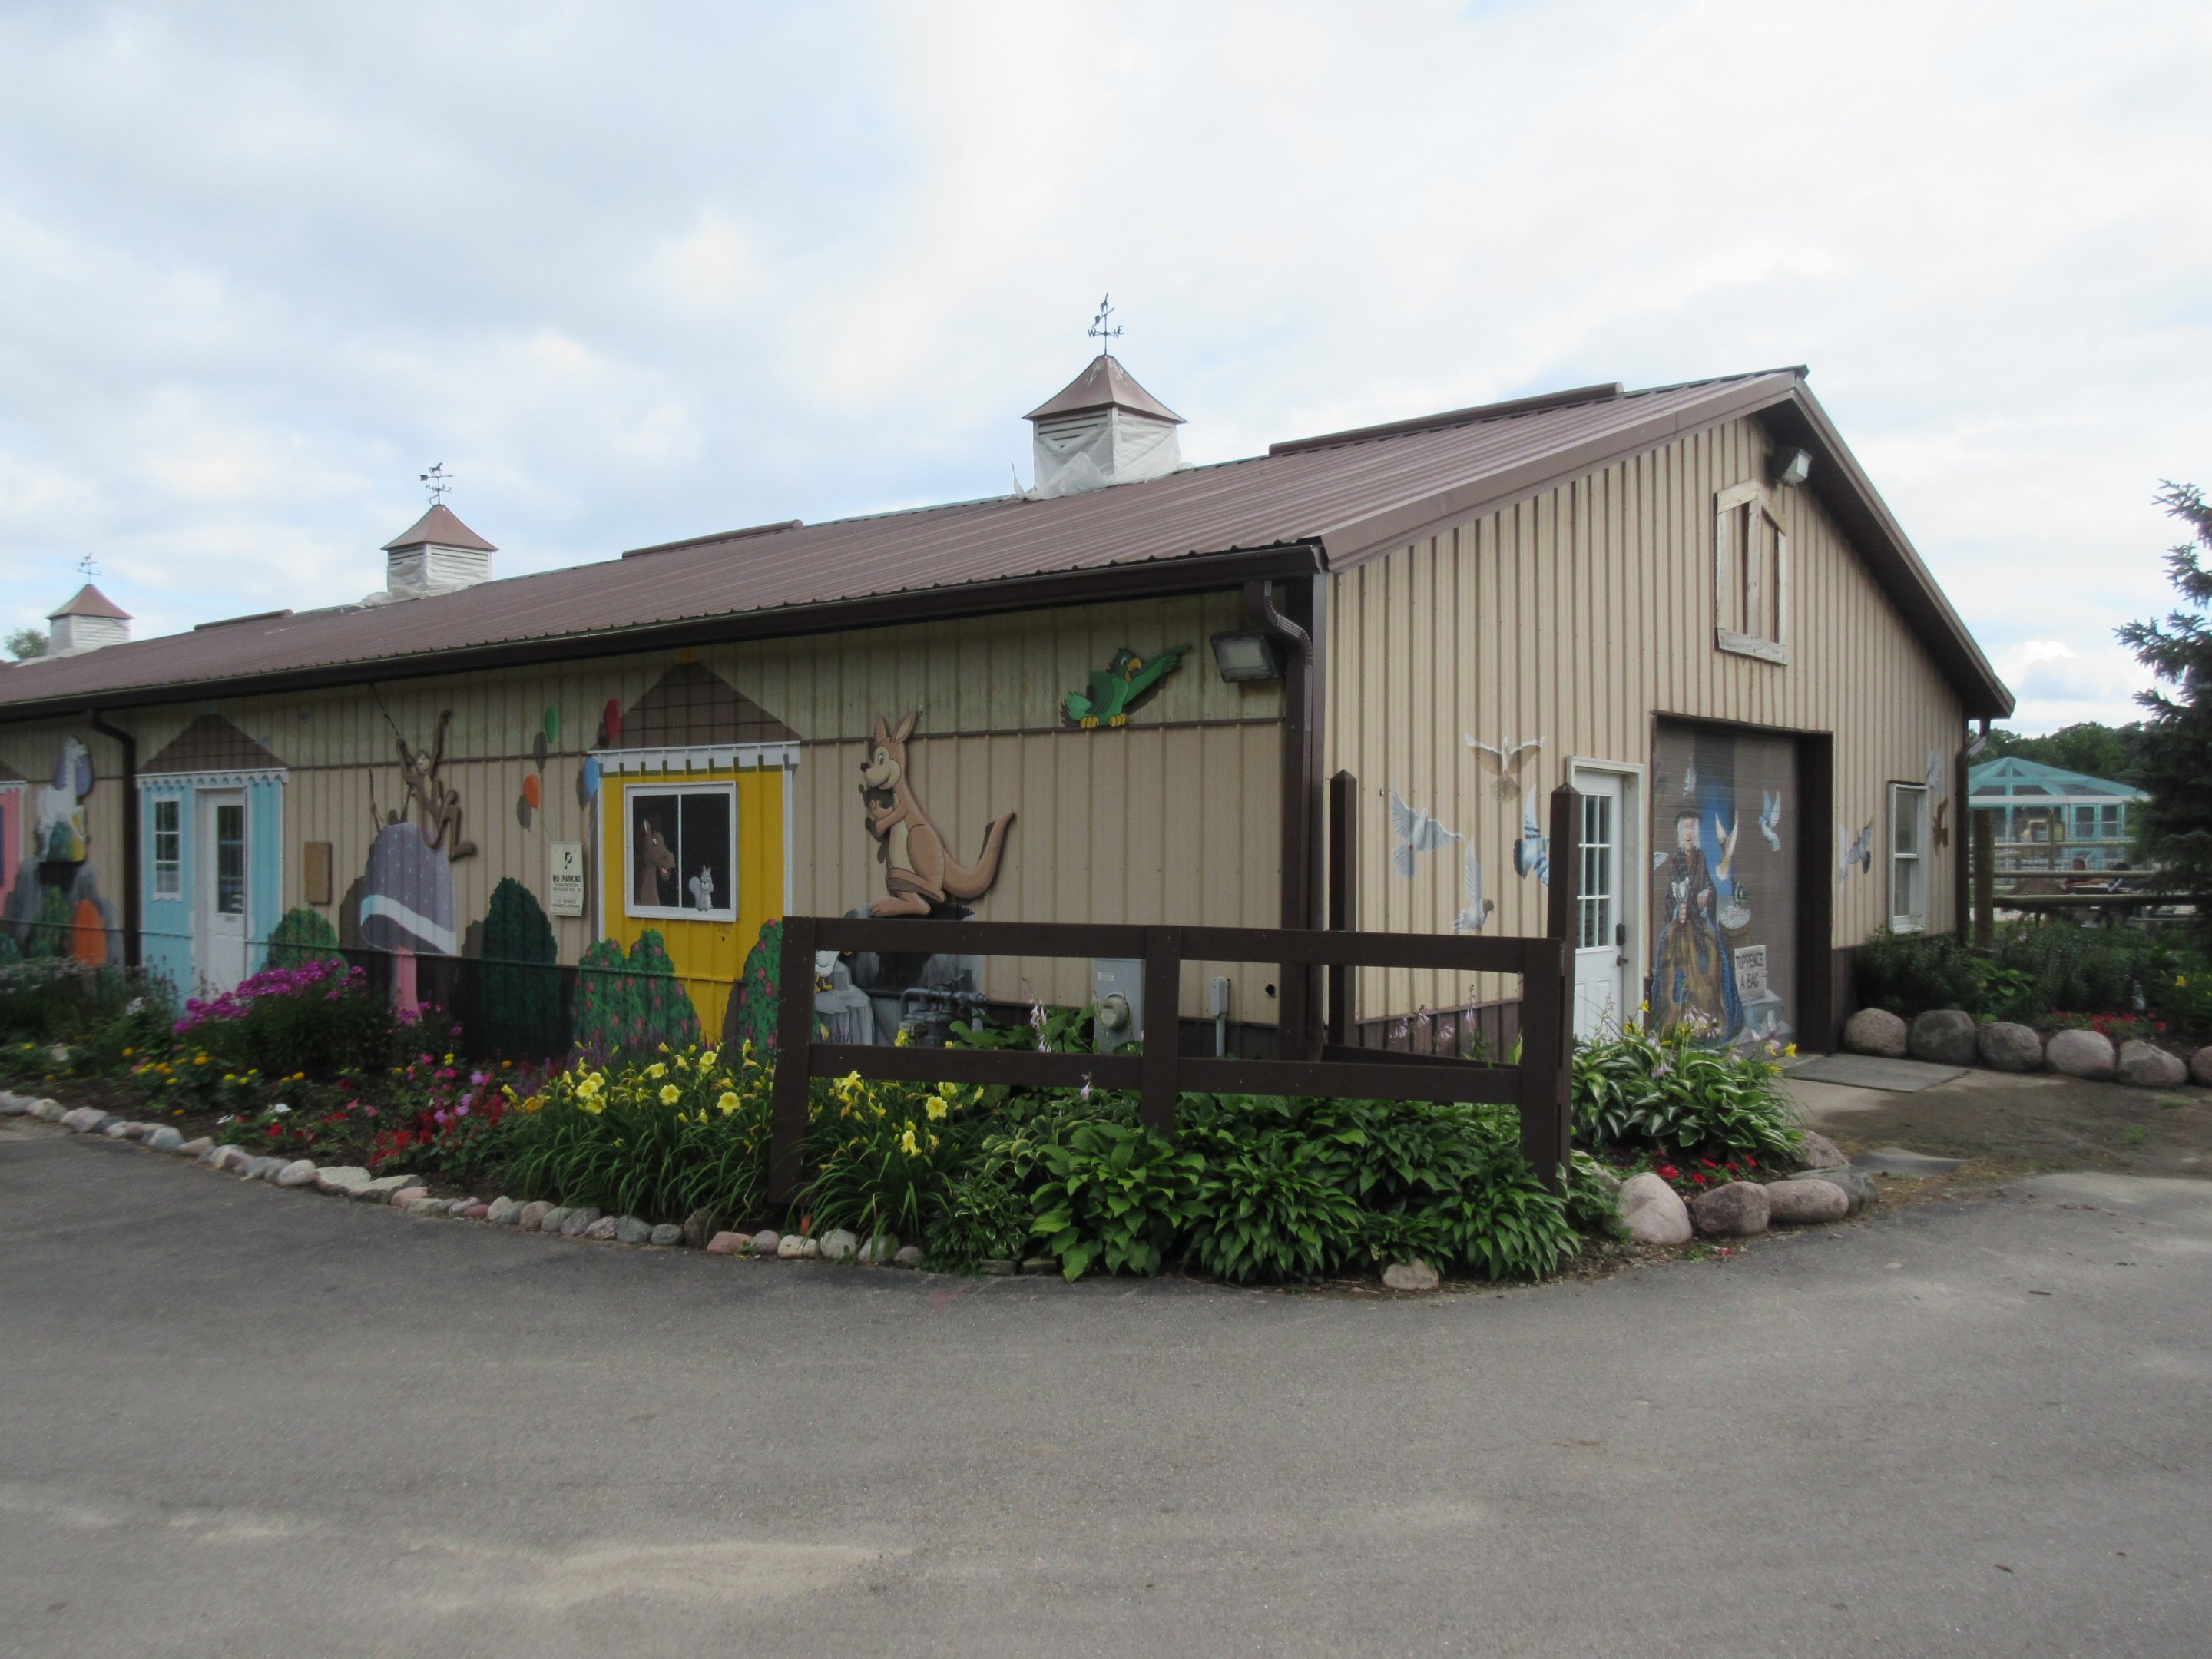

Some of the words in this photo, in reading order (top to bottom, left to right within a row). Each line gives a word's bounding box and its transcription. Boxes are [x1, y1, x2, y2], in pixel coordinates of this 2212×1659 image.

[561, 875, 581, 883] PARKING
[1735, 952, 1763, 969] TUPPENCE
[1740, 975, 1746, 990] A
[1747, 972, 1760, 989] BAG
